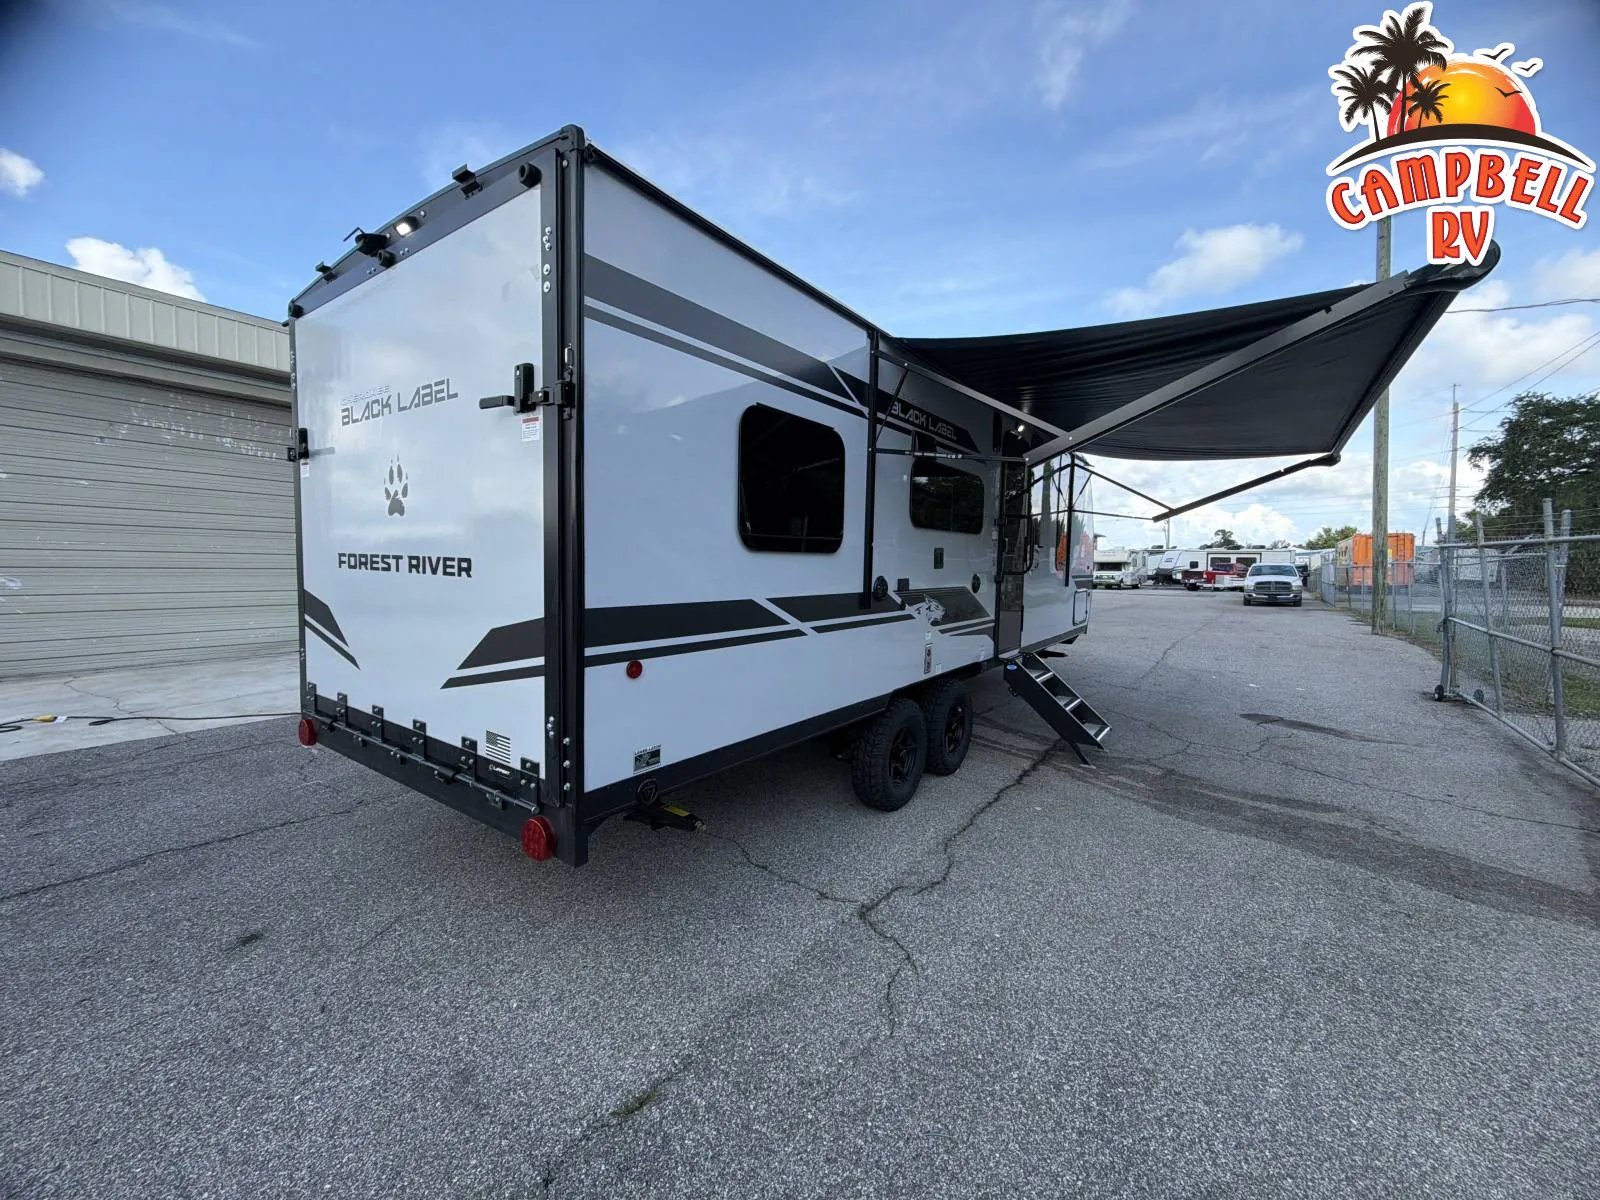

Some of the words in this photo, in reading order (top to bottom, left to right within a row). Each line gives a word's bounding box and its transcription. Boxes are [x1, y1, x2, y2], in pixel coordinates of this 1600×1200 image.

[340, 394, 392, 426] BLACK
[397, 378, 459, 412] LABEL
[890, 401, 927, 429] BLACK
[928, 417, 957, 440] LABEL
[337, 552, 404, 573] FOREST
[407, 555, 473, 578] RIVER
